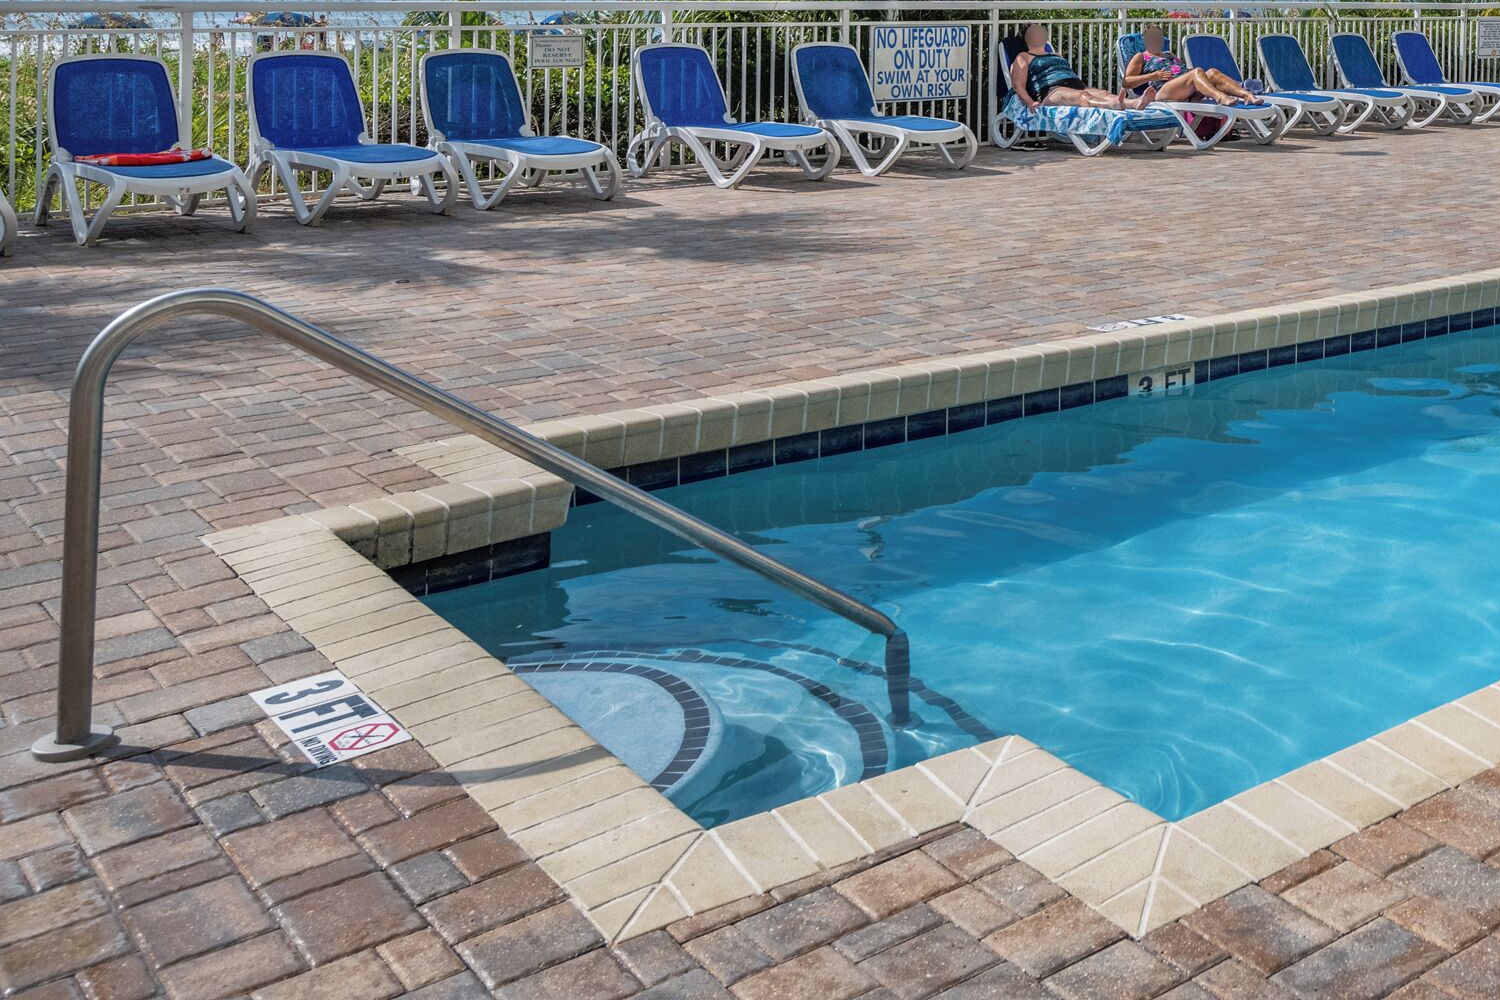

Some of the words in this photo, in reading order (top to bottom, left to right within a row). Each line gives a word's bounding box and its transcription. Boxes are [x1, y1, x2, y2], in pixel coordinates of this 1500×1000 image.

[877, 29, 897, 49] NO
[902, 28, 967, 48] LIFEGUARD
[894, 50, 914, 69] ON
[919, 49, 951, 68] DUTY
[877, 71, 911, 85] SWIM
[916, 70, 931, 83] AT
[934, 68, 965, 82] YOUR
[891, 84, 923, 98] OWN
[928, 82, 952, 97] RISK
[1165, 368, 1191, 389] FT
[264, 679, 345, 705] 3
[278, 694, 378, 734] FT
